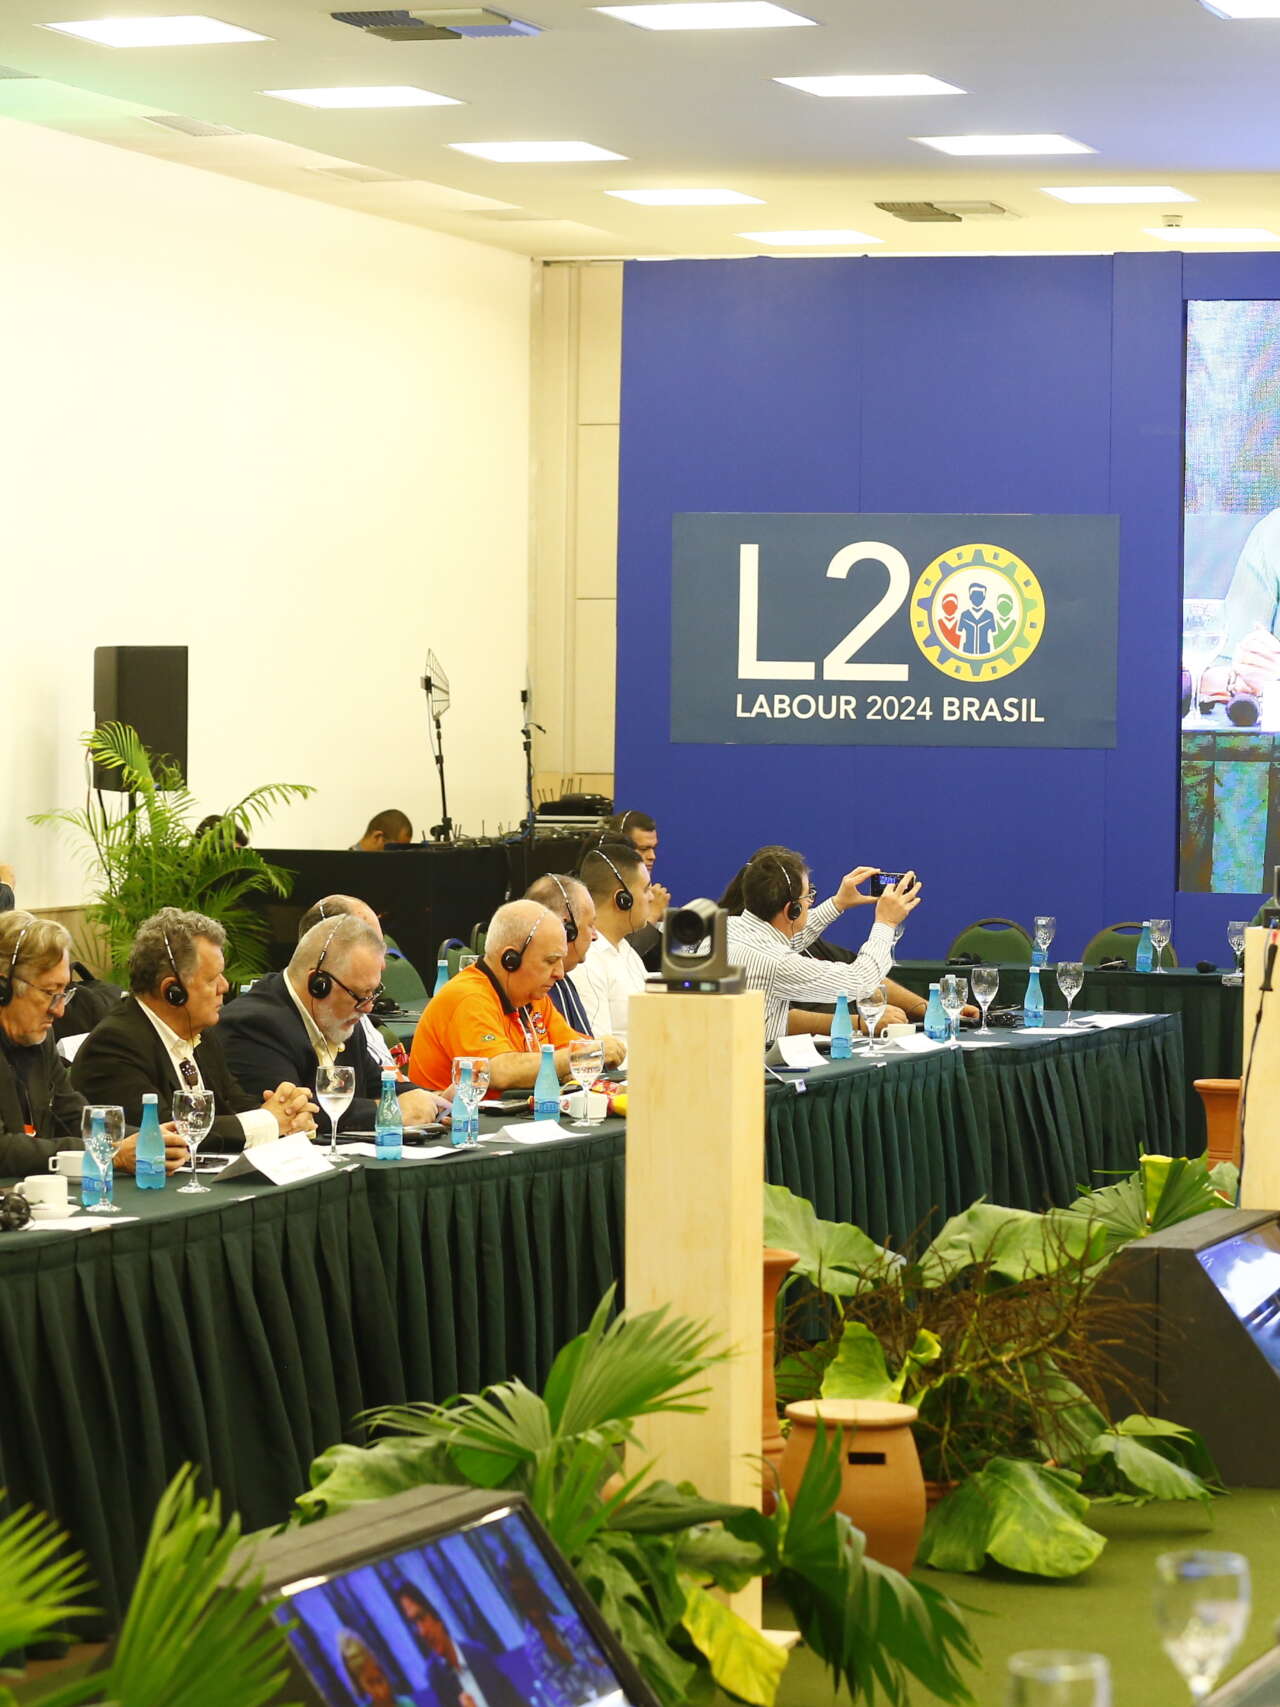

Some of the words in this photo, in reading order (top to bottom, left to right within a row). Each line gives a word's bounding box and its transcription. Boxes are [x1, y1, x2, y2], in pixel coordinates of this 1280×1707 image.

[736, 693, 857, 720] LABOUR
[866, 695, 933, 721] 2024
[943, 696, 1045, 723] BRASIL
